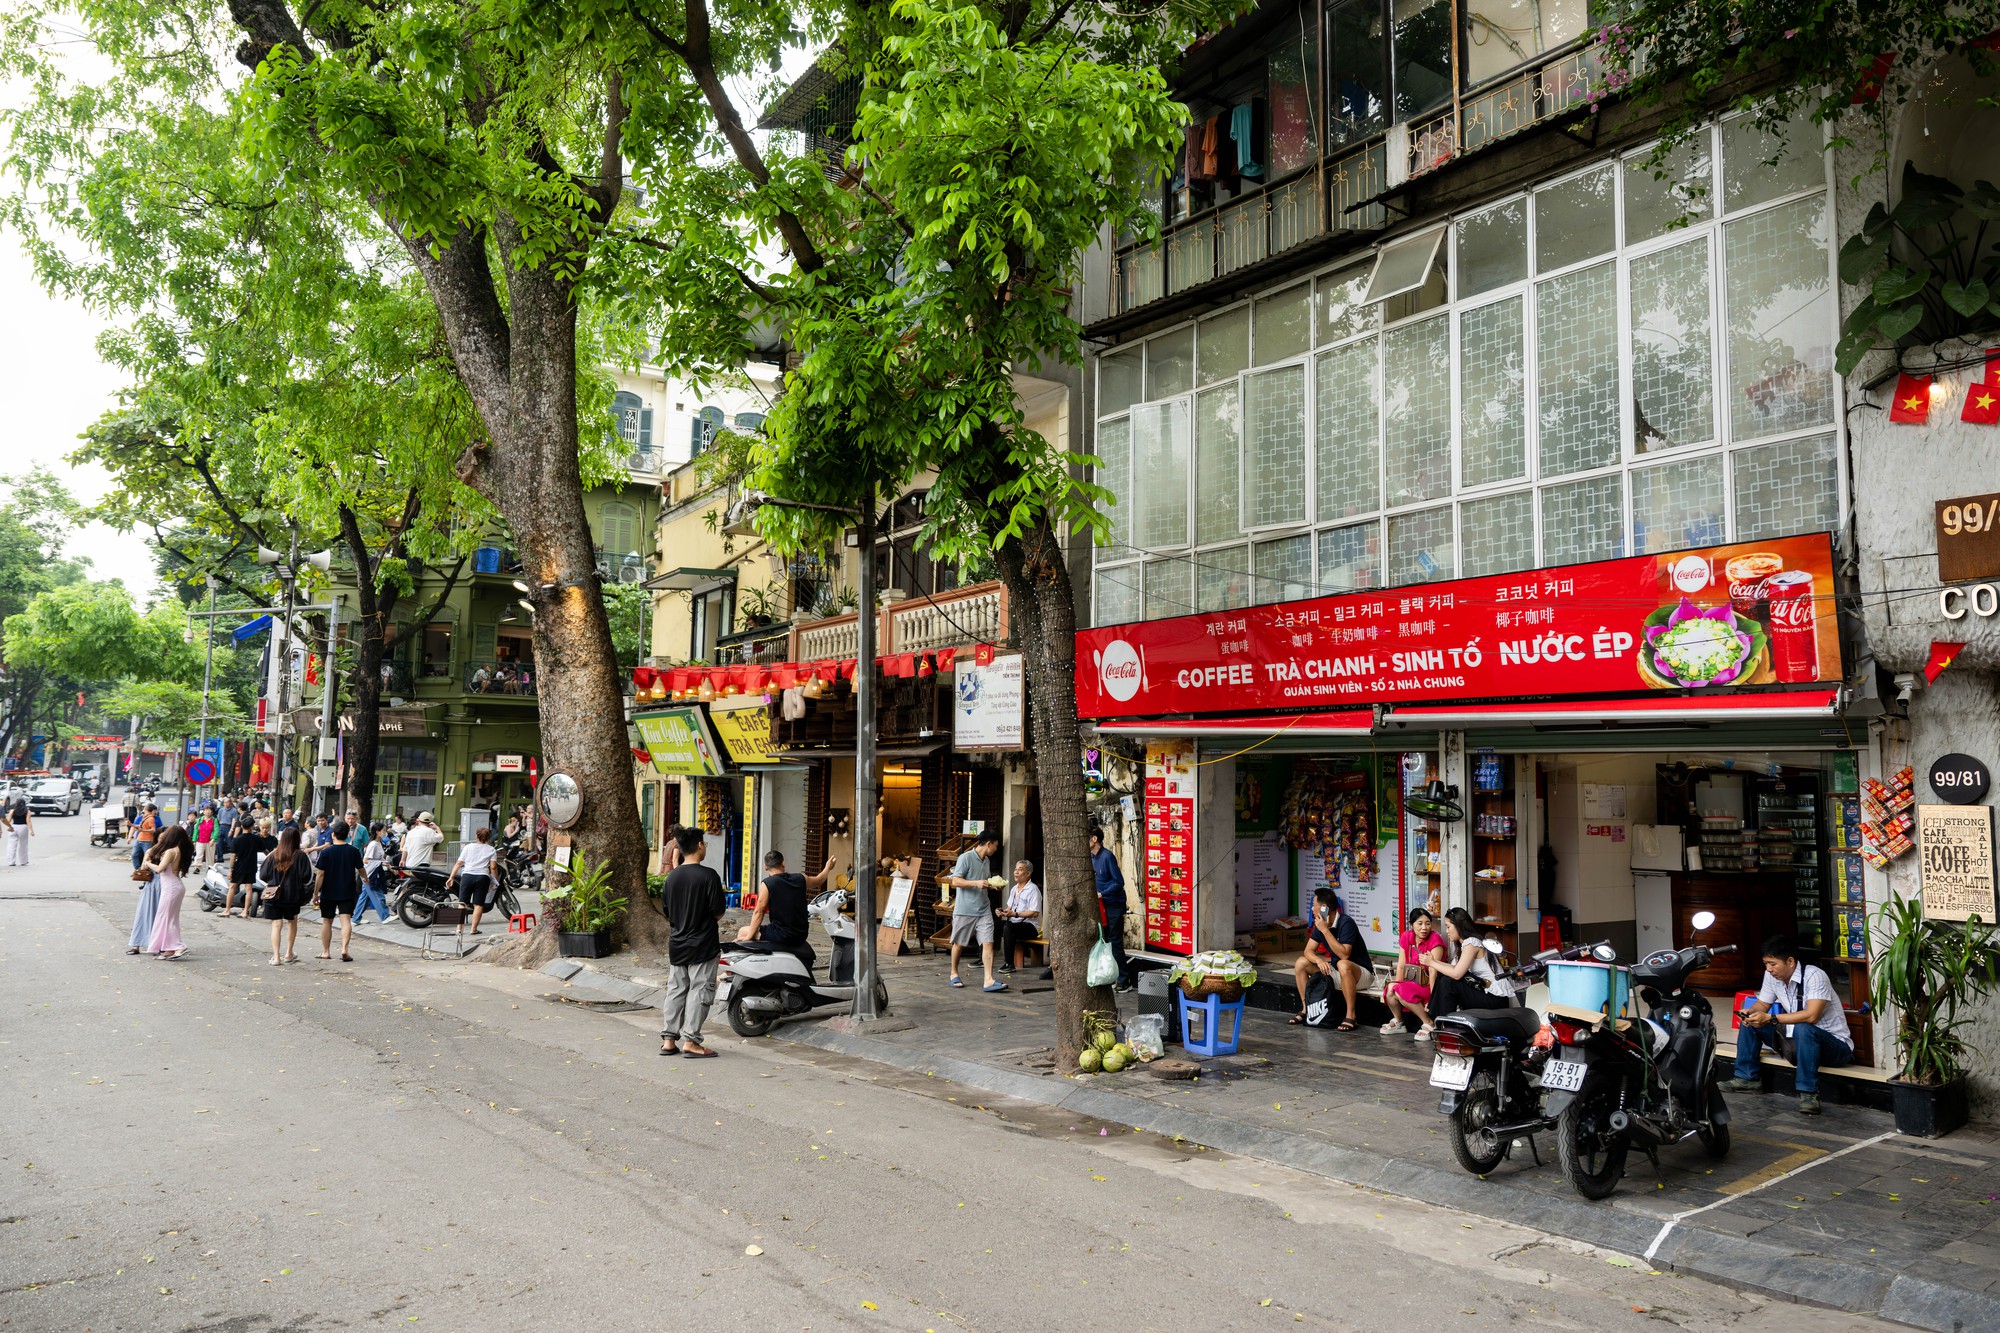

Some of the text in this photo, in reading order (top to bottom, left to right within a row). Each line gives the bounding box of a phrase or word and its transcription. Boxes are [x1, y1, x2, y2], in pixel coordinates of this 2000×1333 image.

[1942, 499, 2000, 536] 99/
[1676, 567, 1706, 580] Coca-Cola
[1227, 618, 1247, 634] 커피
[1274, 613, 1295, 628] 소금
[1298, 609, 1320, 626] 커피
[1333, 605, 1357, 622] 밀크
[1360, 601, 1384, 618] 커피
[1399, 596, 1424, 615] 블랙
[1428, 592, 1455, 611] 커피
[1495, 583, 1538, 603] 코코넛
[1544, 578, 1574, 598] 커피
[1177, 663, 1254, 689] COFFEE
[1265, 657, 1302, 682] TRÀ
[1304, 655, 1375, 680] CHANH
[1392, 649, 1444, 673] SINH
[1448, 636, 1482, 669] TỐ
[1499, 630, 1586, 666] NƯỚC
[1592, 626, 1633, 659] ÉP
[1105, 660, 1138, 680] Coca-Cola
[1284, 682, 1312, 697] QUÁN
[1313, 682, 1336, 695] SINH
[1338, 679, 1362, 693] VIÊN
[1371, 676, 1386, 691] SỐ
[1388, 680, 1396, 691] 2
[1397, 676, 1422, 690] NHÀ
[1423, 675, 1465, 690] CHUNG
[1934, 770, 1982, 787] 99/81
[444, 784, 456, 796] 27
[1923, 817, 1985, 828] ICED STRONG
[1923, 828, 1946, 837] CAFE
[1970, 858, 1988, 866] HOT
[1932, 875, 1964, 884] MOCHA
[1926, 883, 1965, 894] ROASTED
[1946, 903, 1993, 913] ESPRESSO
[1306, 998, 1328, 1020] NIKE
[1552, 1061, 1580, 1076] 19-B1
[1542, 1074, 1580, 1089] 226.31
